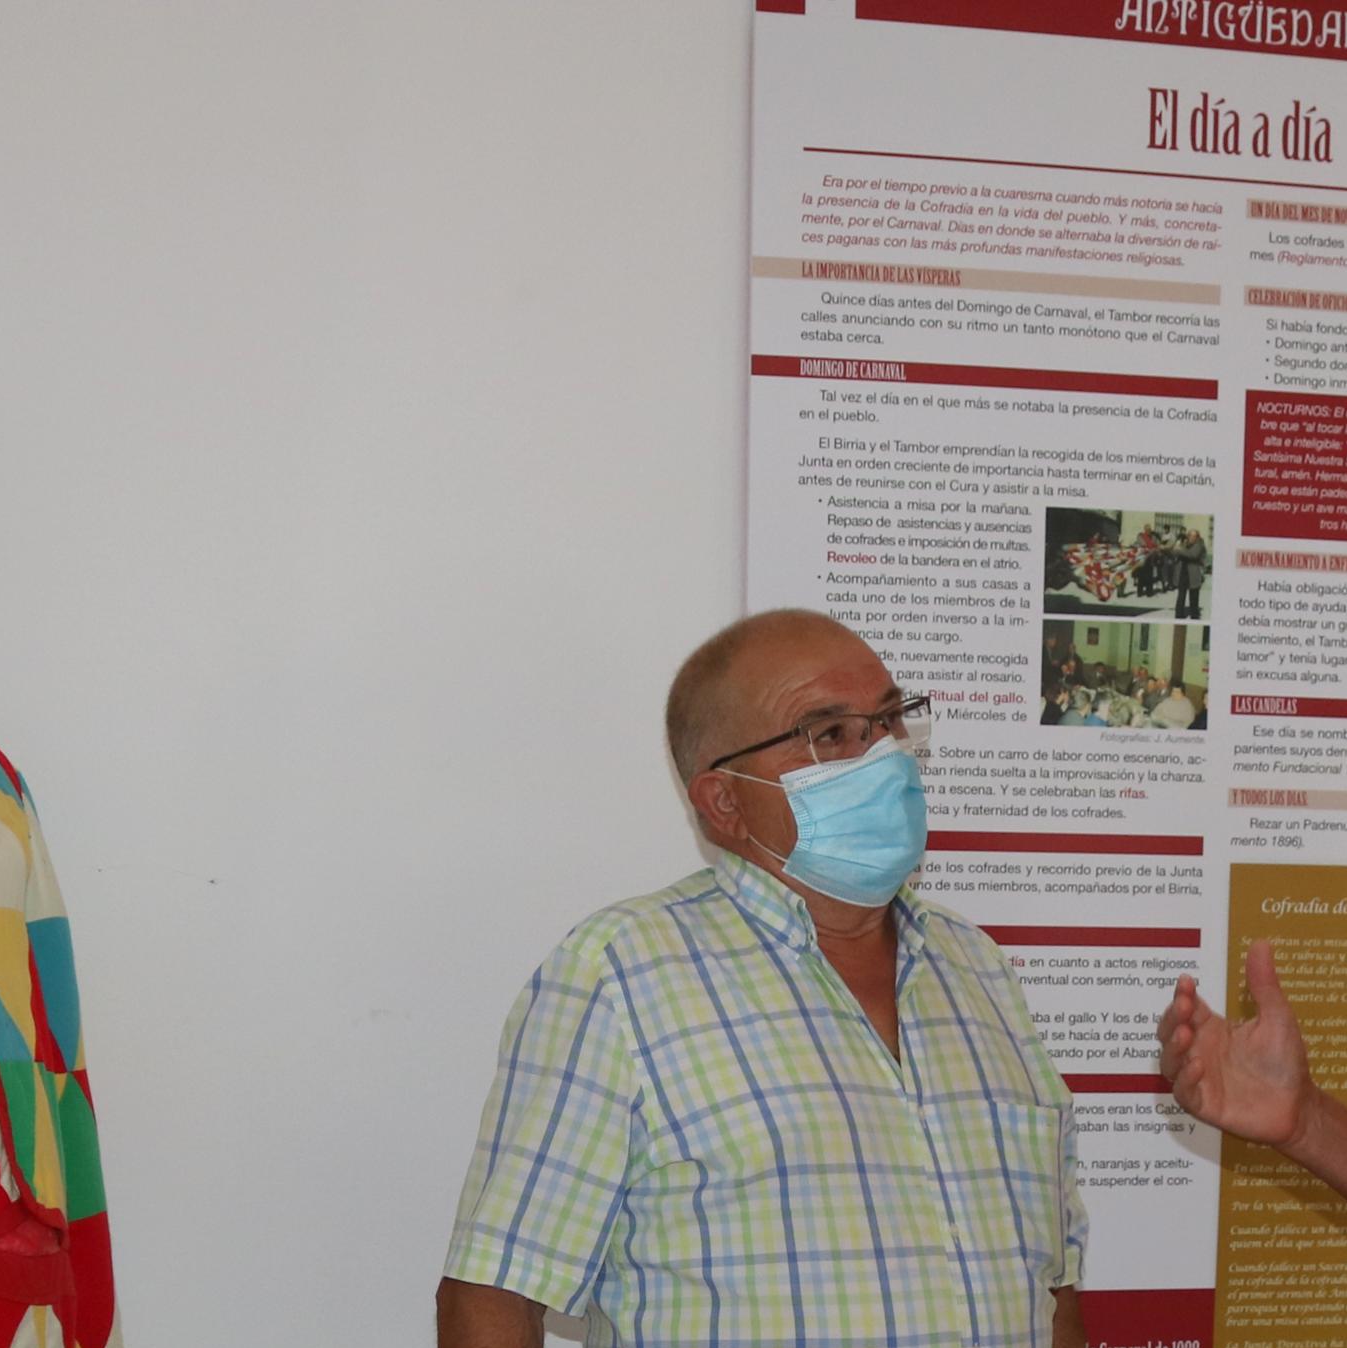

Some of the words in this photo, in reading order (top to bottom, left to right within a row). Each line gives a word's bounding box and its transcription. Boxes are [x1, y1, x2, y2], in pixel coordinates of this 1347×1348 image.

[1148, 87, 1178, 150] El
[1189, 92, 1240, 154] día
[1252, 112, 1269, 157] a
[1281, 100, 1331, 162] día
[821, 174, 843, 188] Era
[844, 178, 868, 190] por
[869, 178, 882, 190] el
[883, 179, 927, 194] tiempo
[928, 183, 968, 196] previo
[969, 186, 978, 197] a
[980, 185, 991, 197] la
[993, 188, 1053, 201] cuaresma
[1054, 193, 1101, 205] cuando
[1102, 195, 1128, 207] más
[1130, 198, 1172, 210] notoria
[1174, 201, 1189, 211] se
[1191, 201, 1223, 214] hacía
[1302, 205, 1320, 222] MES
[1322, 206, 1334, 223] DE
[1248, 250, 1274, 261] mes
[802, 261, 813, 278] LA
[817, 262, 880, 282] IMPORTANCIA
[883, 266, 896, 282] DE
[898, 266, 914, 284] LAS
[917, 266, 960, 286] VÍSPERAS
[820, 291, 866, 305] Quince
[868, 294, 895, 307] días
[897, 297, 932, 309] antes
[934, 298, 954, 311] del
[956, 299, 1013, 316] Domingo
[1014, 303, 1031, 315] de
[1033, 303, 1093, 320] Carnaval,
[1093, 308, 1105, 320] el
[1108, 308, 1152, 322] Tambor
[1202, 315, 1220, 327] las
[1309, 293, 1320, 310] DE
[800, 310, 837, 323] calles
[841, 314, 915, 327] anunciando
[918, 318, 943, 328] con
[946, 319, 962, 330] su
[966, 319, 999, 332] ritmo
[1002, 323, 1019, 333] un
[1022, 322, 1055, 335] tanto
[1058, 326, 1121, 339] monótono
[1124, 330, 1148, 342] que
[1151, 330, 1163, 342] el
[1166, 330, 1220, 345] Carnaval
[800, 329, 843, 342] estaba
[846, 333, 884, 344] cerca.
[800, 358, 844, 377] DOMINGO
[846, 361, 858, 378] DE
[860, 362, 906, 380] CARNAVAL
[818, 436, 830, 449] El
[833, 436, 866, 450] Birria
[868, 441, 876, 453] y
[878, 439, 890, 451] el
[893, 439, 939, 453] Tambor
[942, 444, 1015, 457] emprendían
[1017, 446, 1029, 458] la
[1031, 449, 1084, 462] recogida
[1086, 450, 1103, 462] de
[1105, 450, 1123, 463] los
[1125, 454, 1185, 466] miembros
[1187, 455, 1203, 467] de
[1205, 456, 1216, 468] la
[826, 550, 877, 564] Revoleo
[879, 552, 895, 565] de
[897, 553, 909, 565] la
[910, 554, 960, 567] bandera
[961, 558, 977, 567] en
[979, 556, 991, 568] el
[992, 558, 1022, 569] atrio.
[1240, 551, 1319, 570] ACOMPAÑAMIENTO
[1321, 554, 1327, 570] A
[825, 571, 937, 587] Acompañamiento
[941, 578, 950, 588] a
[954, 578, 977, 588] sus
[981, 579, 1018, 590] casas
[1022, 581, 1031, 591] a
[928, 689, 964, 702] Ritual
[969, 691, 988, 702] del
[994, 692, 1026, 705] gallo.
[1236, 696, 1252, 713] LAS
[1253, 697, 1297, 714] CANDELAS
[938, 745, 976, 758] Sobre
[978, 749, 994, 759] un
[997, 750, 1029, 760] carro
[1032, 749, 1048, 760] de
[1051, 749, 1082, 761] labor
[1085, 752, 1120, 762] como
[1122, 753, 1185, 764] escenario,
[1186, 755, 1205, 765] ac-
[1232, 761, 1270, 772] mento
[1272, 760, 1342, 774] Fundacional
[1240, 789, 1268, 805] TODOS
[1269, 790, 1284, 806] LOS
[1090, 1159, 1140, 1171] naranjas
[1143, 1160, 1150, 1171] y
[1153, 1158, 1193, 1169] aceitu-
